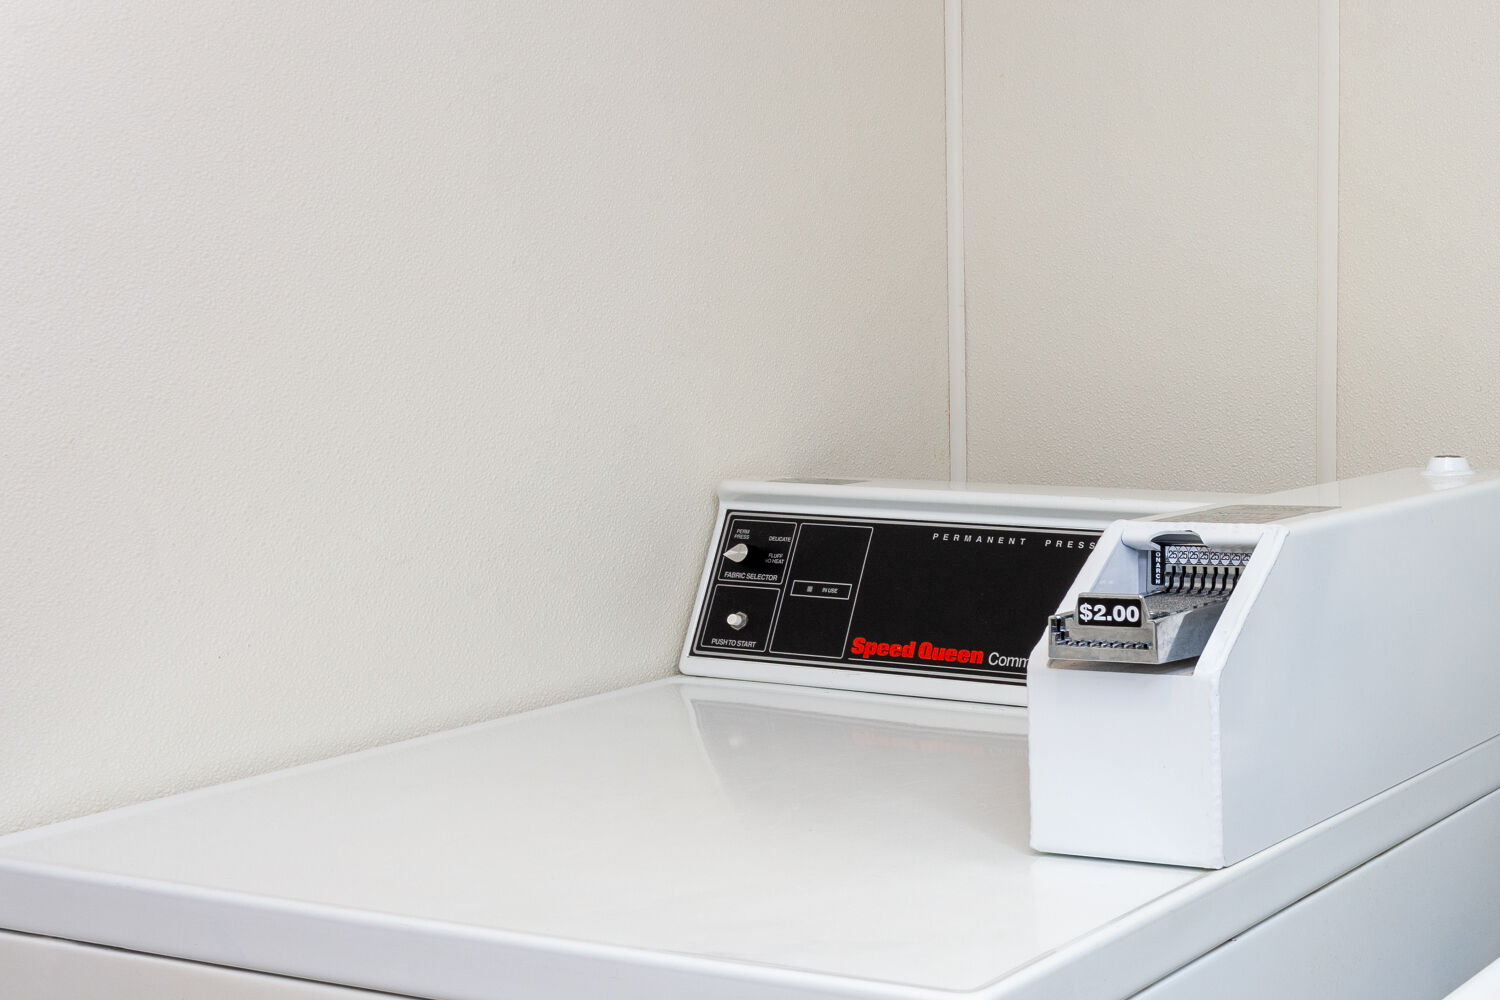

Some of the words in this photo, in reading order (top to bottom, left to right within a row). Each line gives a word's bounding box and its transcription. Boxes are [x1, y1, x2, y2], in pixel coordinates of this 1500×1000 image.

[768, 535, 792, 543] DELICATE
[932, 532, 1027, 546] PERMANENT
[1044, 539, 1097, 550] PRESS
[723, 571, 746, 579] FABRIC
[745, 573, 778, 581] SELECTOR
[1079, 602, 1140, 623] $2.00
[736, 640, 757, 648] START
[850, 637, 917, 659] Speed
[918, 641, 984, 665] Queen
